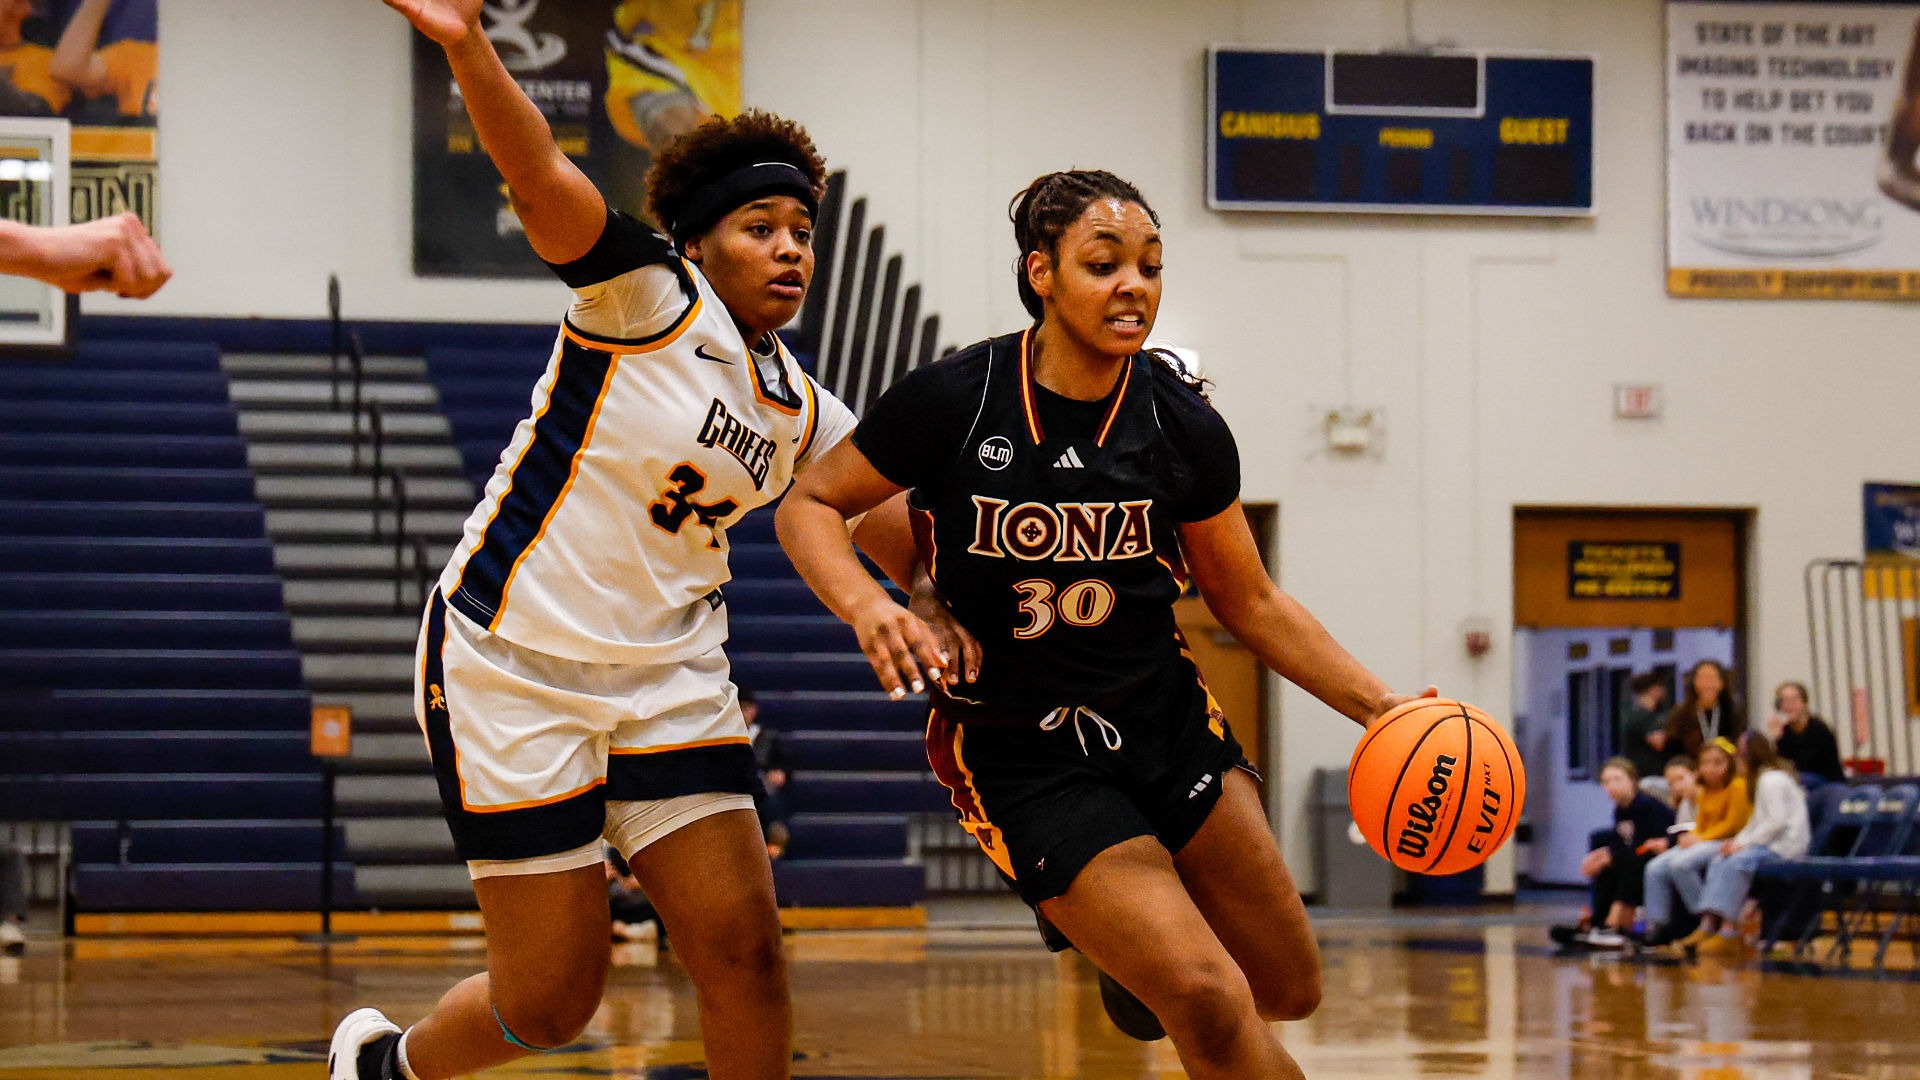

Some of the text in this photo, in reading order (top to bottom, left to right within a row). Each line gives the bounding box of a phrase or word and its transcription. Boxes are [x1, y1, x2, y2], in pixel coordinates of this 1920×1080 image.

[1698, 22, 1753, 45] STATE
[1795, 22, 1829, 45] THE
[1499, 117, 1569, 145] GUEST
[981, 444, 1010, 463] BLM
[967, 494, 1153, 562] IONA
[1012, 578, 1116, 640] 30
[1397, 754, 1457, 858] Wilson
